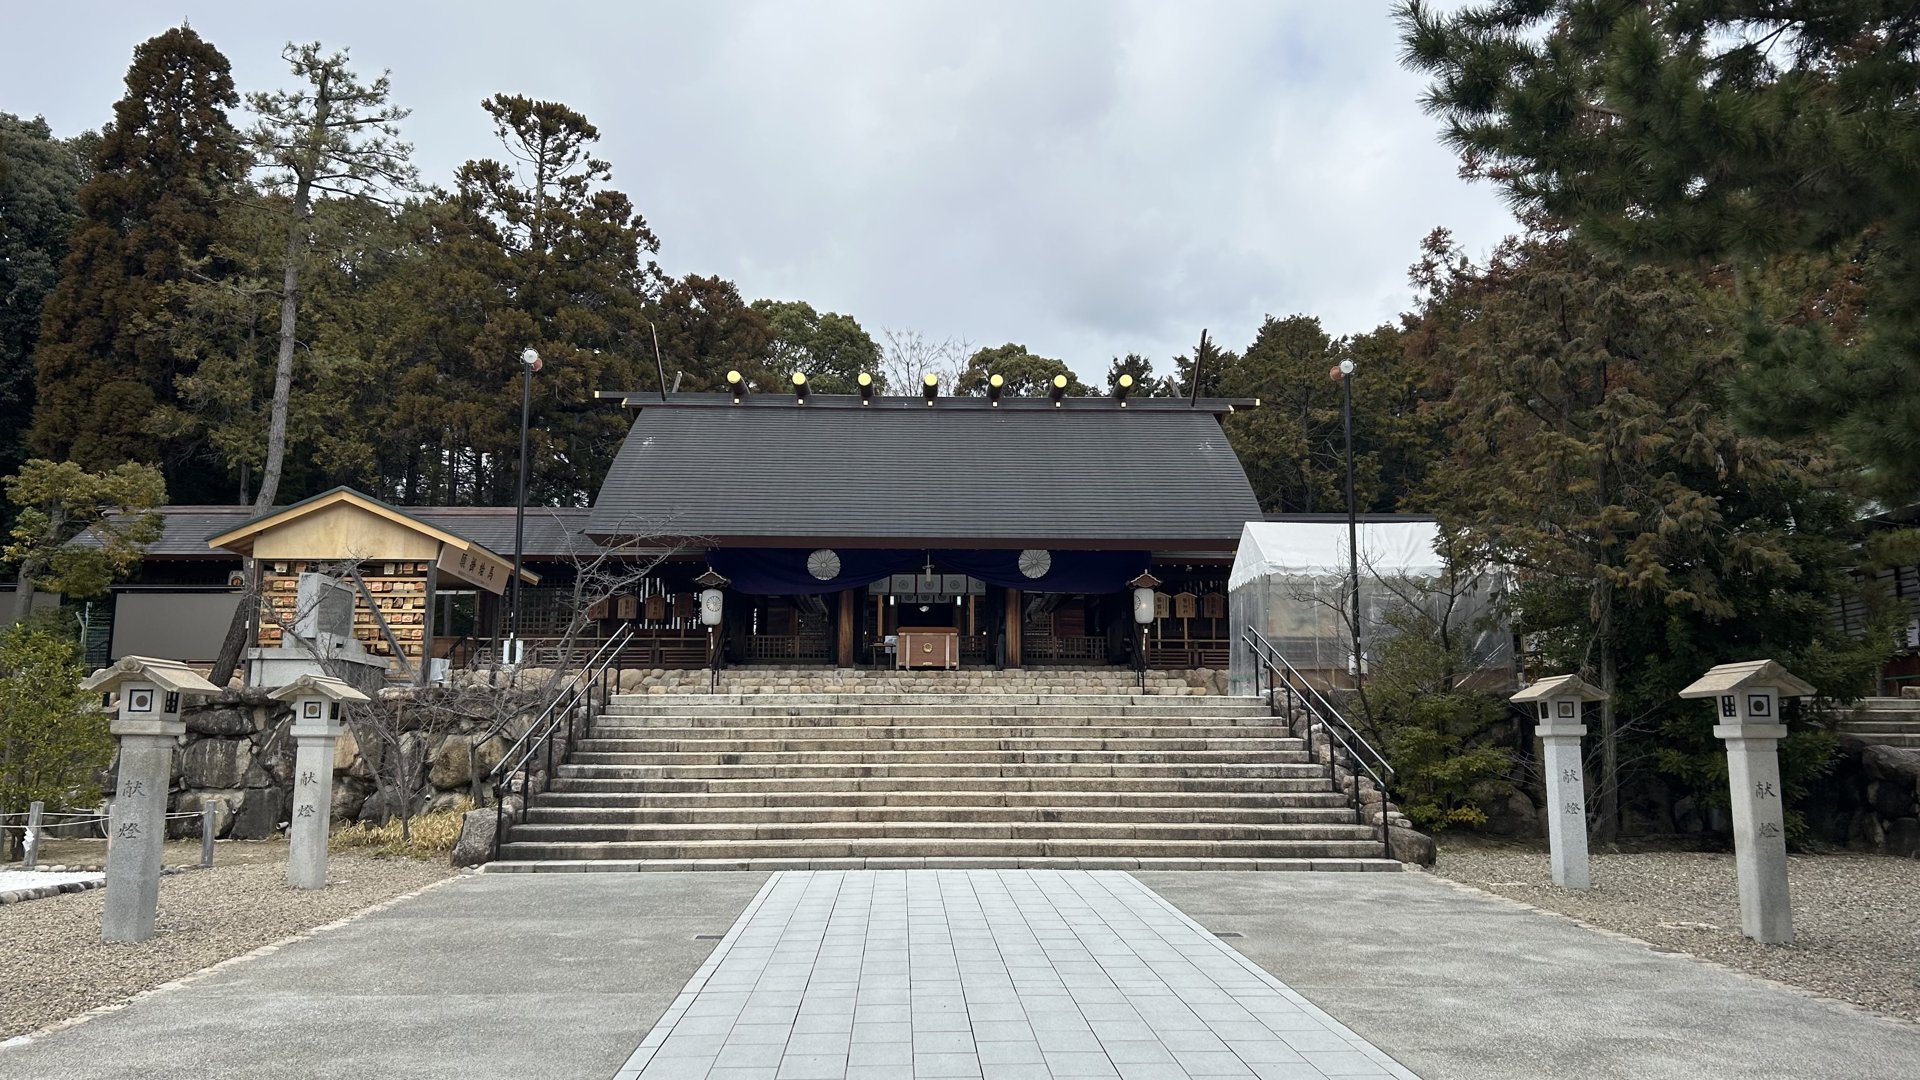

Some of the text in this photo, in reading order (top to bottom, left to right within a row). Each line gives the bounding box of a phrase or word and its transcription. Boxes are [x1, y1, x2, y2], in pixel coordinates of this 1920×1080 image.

[118, 780, 146, 839] 献燈
[297, 771, 318, 818] 献燈
[1562, 769, 1581, 815] 献燈
[1755, 781, 1779, 838] 献燈
